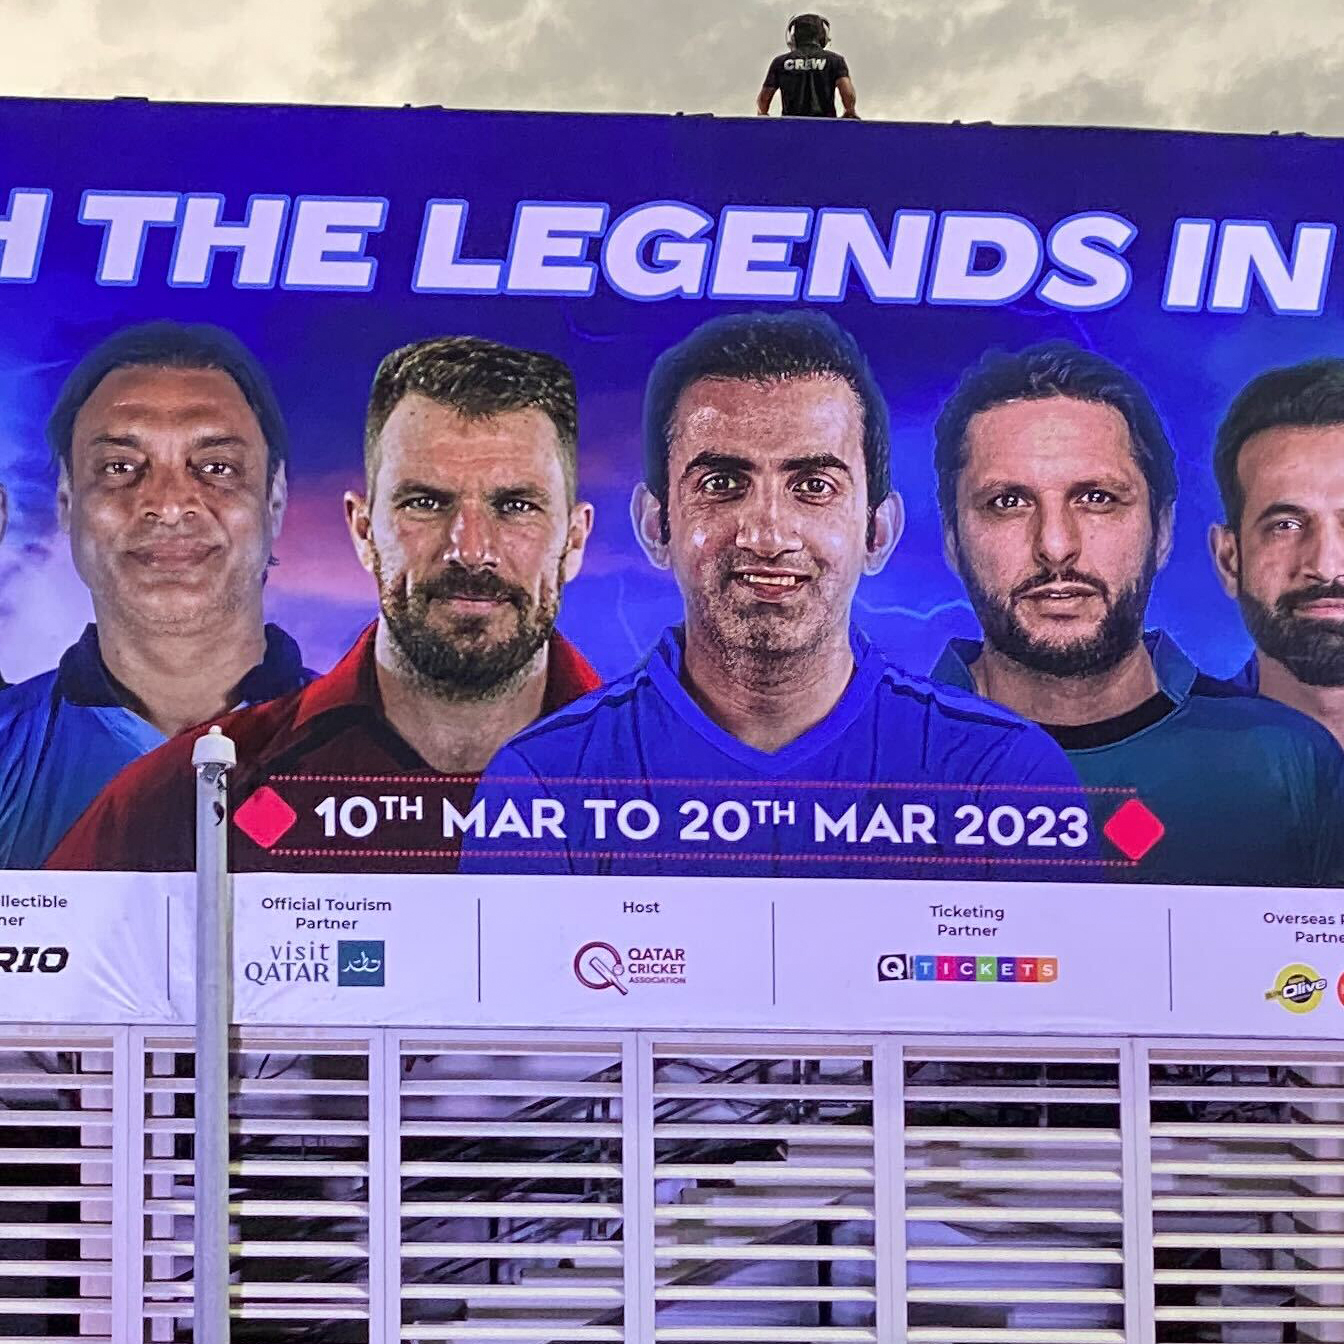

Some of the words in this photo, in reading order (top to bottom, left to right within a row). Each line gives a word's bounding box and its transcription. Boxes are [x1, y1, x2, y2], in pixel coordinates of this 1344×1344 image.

[783, 59, 827, 71] CREW
[78, 189, 389, 292] THE
[411, 198, 1139, 312] LEGENDS
[1162, 218, 1337, 315] IN
[314, 795, 425, 839] 10TH
[443, 797, 566, 842] MAR
[583, 798, 662, 843] TO
[678, 800, 796, 845] 20TH
[815, 802, 938, 847] MAR
[953, 805, 1089, 848] 2023
[261, 897, 321, 912] Official
[324, 898, 393, 913] Tourism
[622, 901, 661, 914] Host
[929, 904, 1005, 922] Ticketing
[295, 917, 359, 930] Partner
[1262, 911, 1336, 927] Overseas
[936, 923, 999, 938] Partner
[270, 940, 331, 961] visit
[627, 947, 686, 962] QATAR
[244, 961, 331, 986] QATAR
[627, 963, 687, 975] CRICKET
